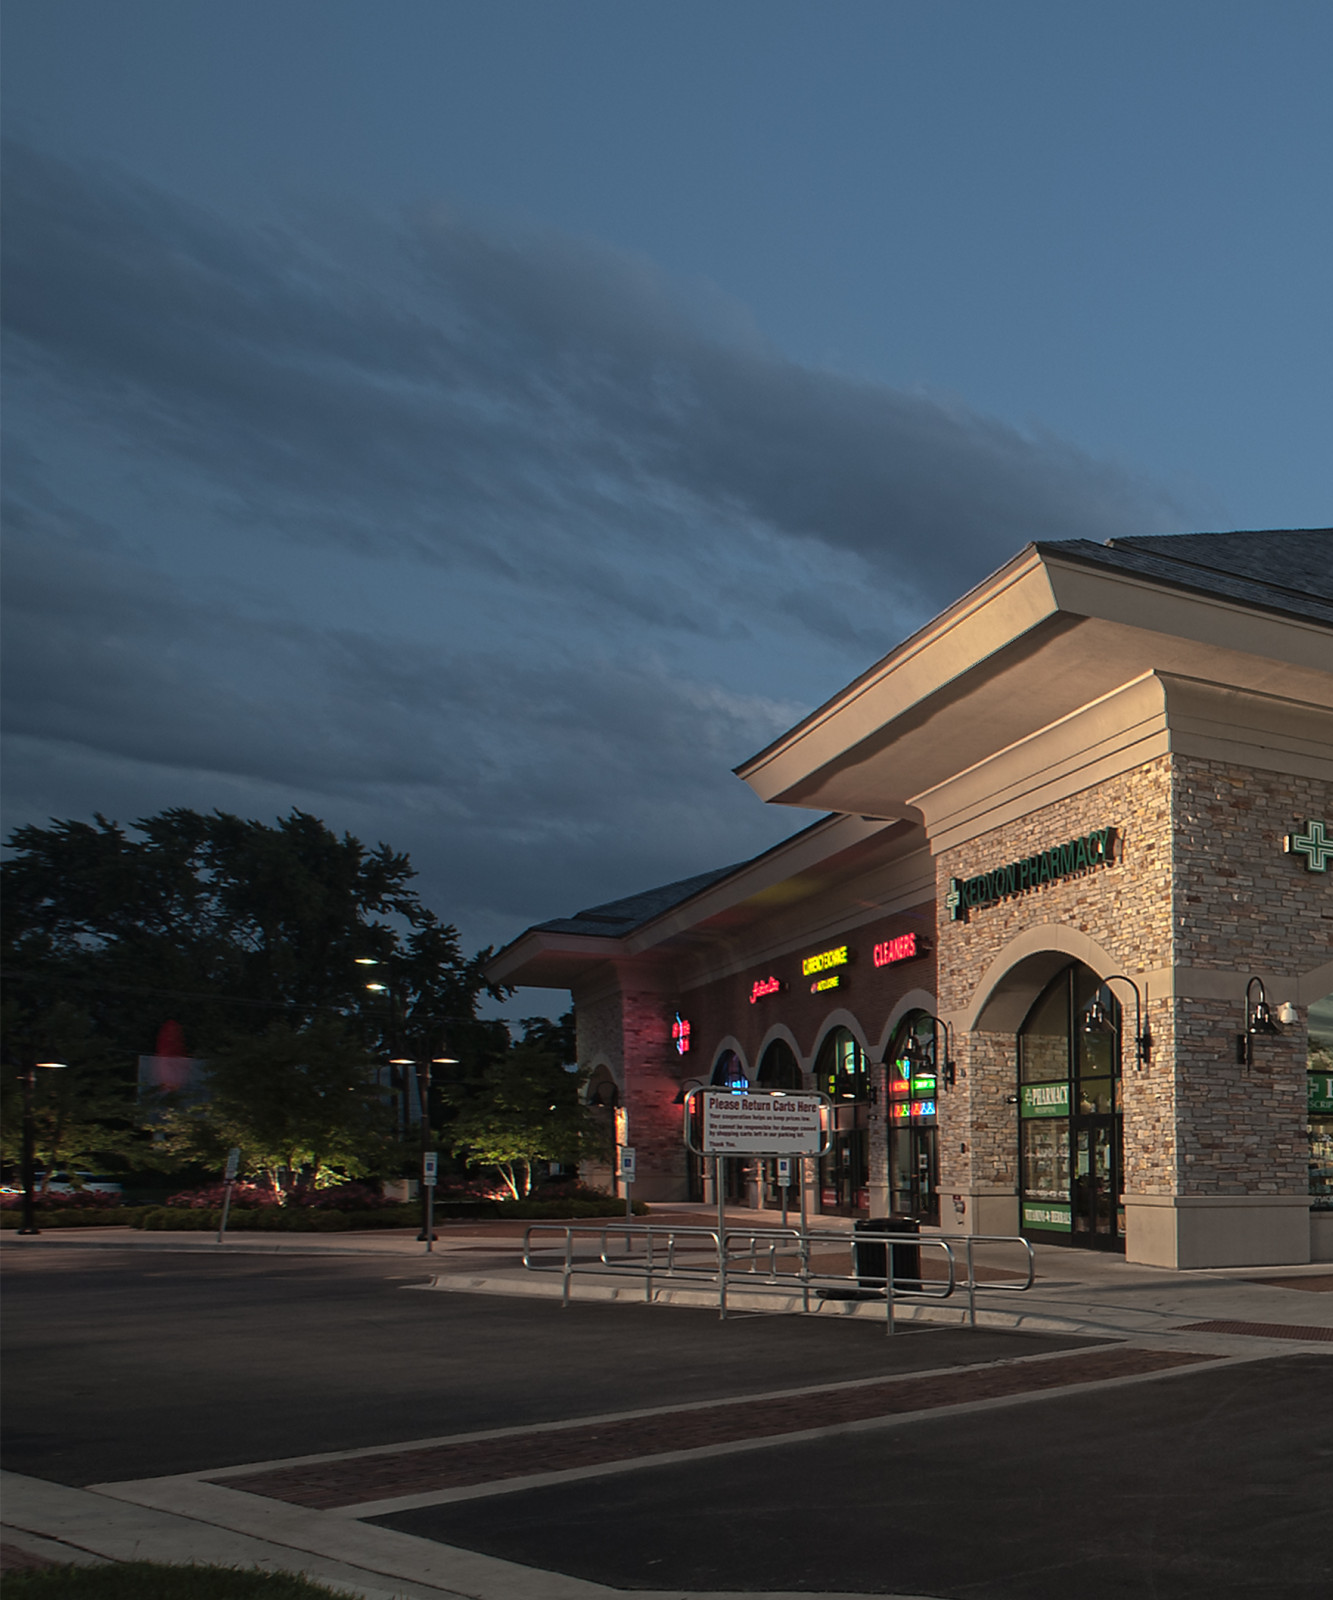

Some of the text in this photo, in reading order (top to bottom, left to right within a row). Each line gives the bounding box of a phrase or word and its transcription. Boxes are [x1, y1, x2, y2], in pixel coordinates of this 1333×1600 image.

[962, 826, 1113, 910] KEDVON PHARMACY
[873, 932, 917, 968] CLEANERS
[710, 1098, 739, 1110] Please
[742, 1099, 770, 1111] Return
[773, 1100, 796, 1112] Carts
[799, 1101, 816, 1112] Here
[1032, 1086, 1069, 1106] PHARMACY
